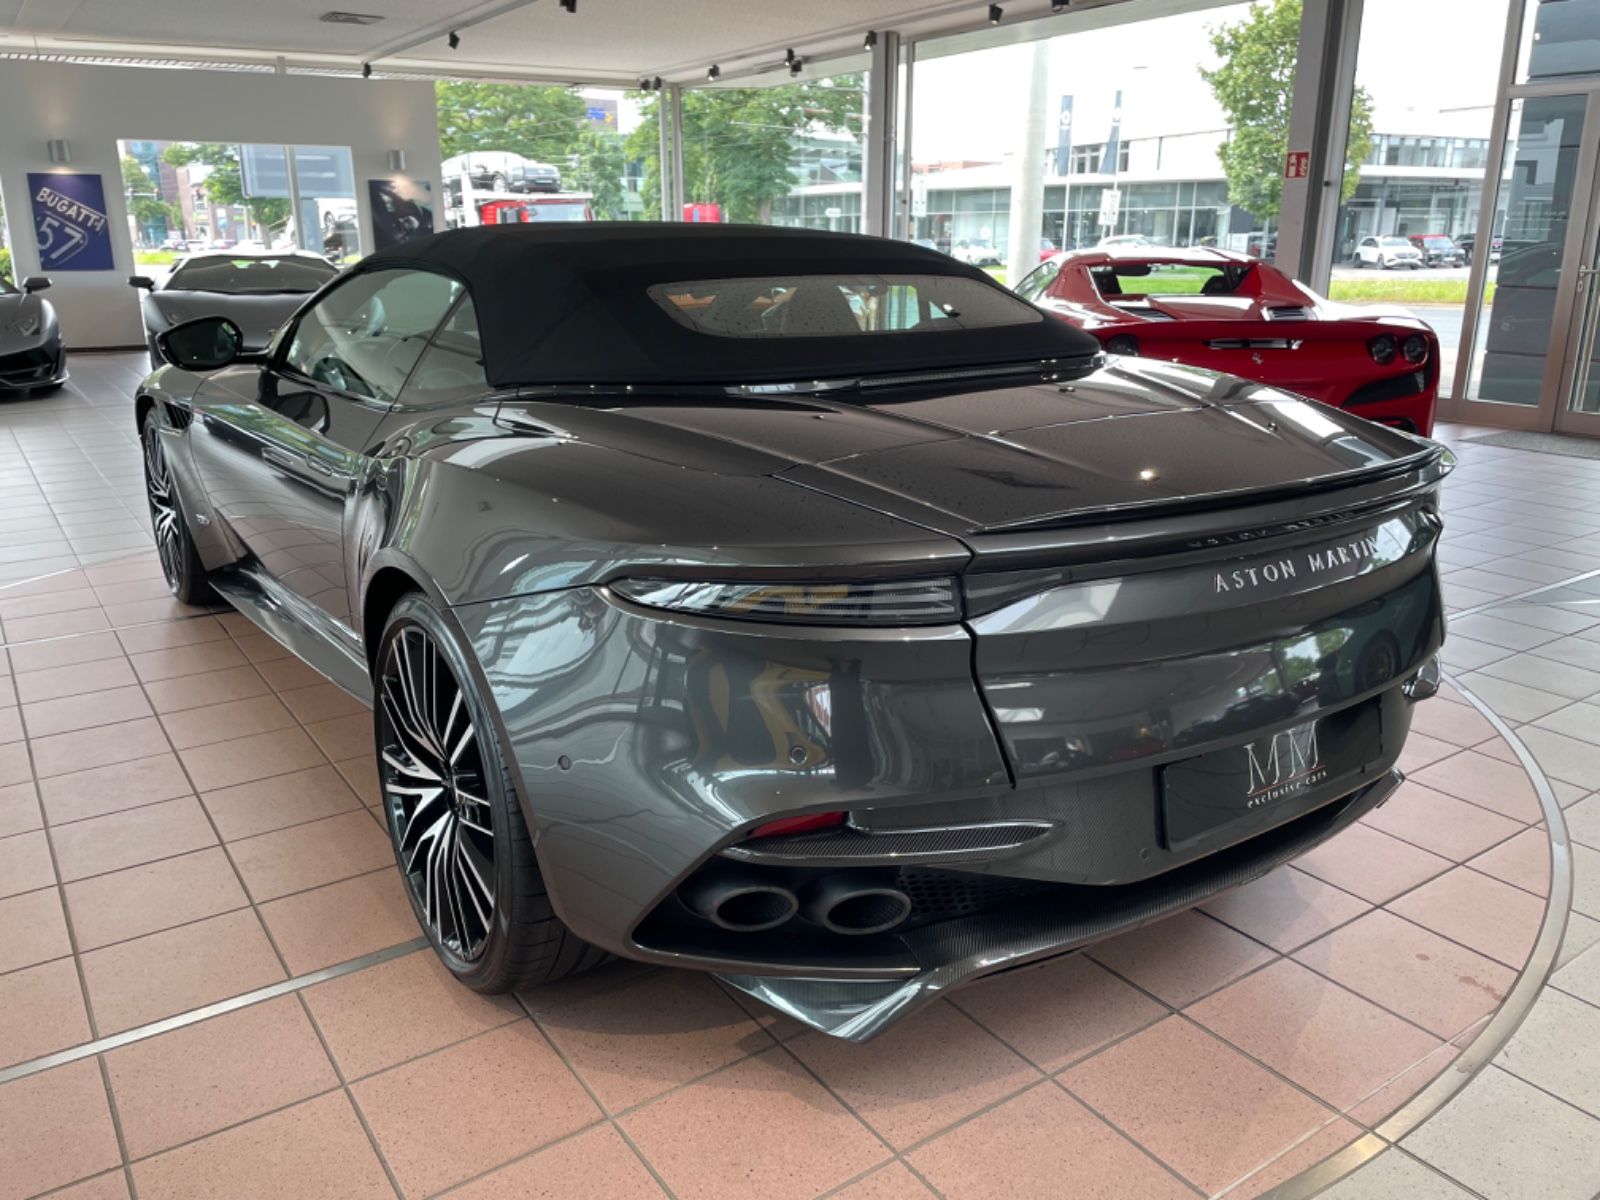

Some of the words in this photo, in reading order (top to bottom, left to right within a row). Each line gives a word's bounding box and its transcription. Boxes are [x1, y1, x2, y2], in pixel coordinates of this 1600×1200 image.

[36, 187, 106, 233] BUGATTI
[1214, 559, 1297, 593] ASTON
[1307, 536, 1379, 573] MARTIN
[1243, 718, 1319, 795] MM
[1247, 782, 1301, 808] exclusive
[1305, 769, 1327, 785] cars
